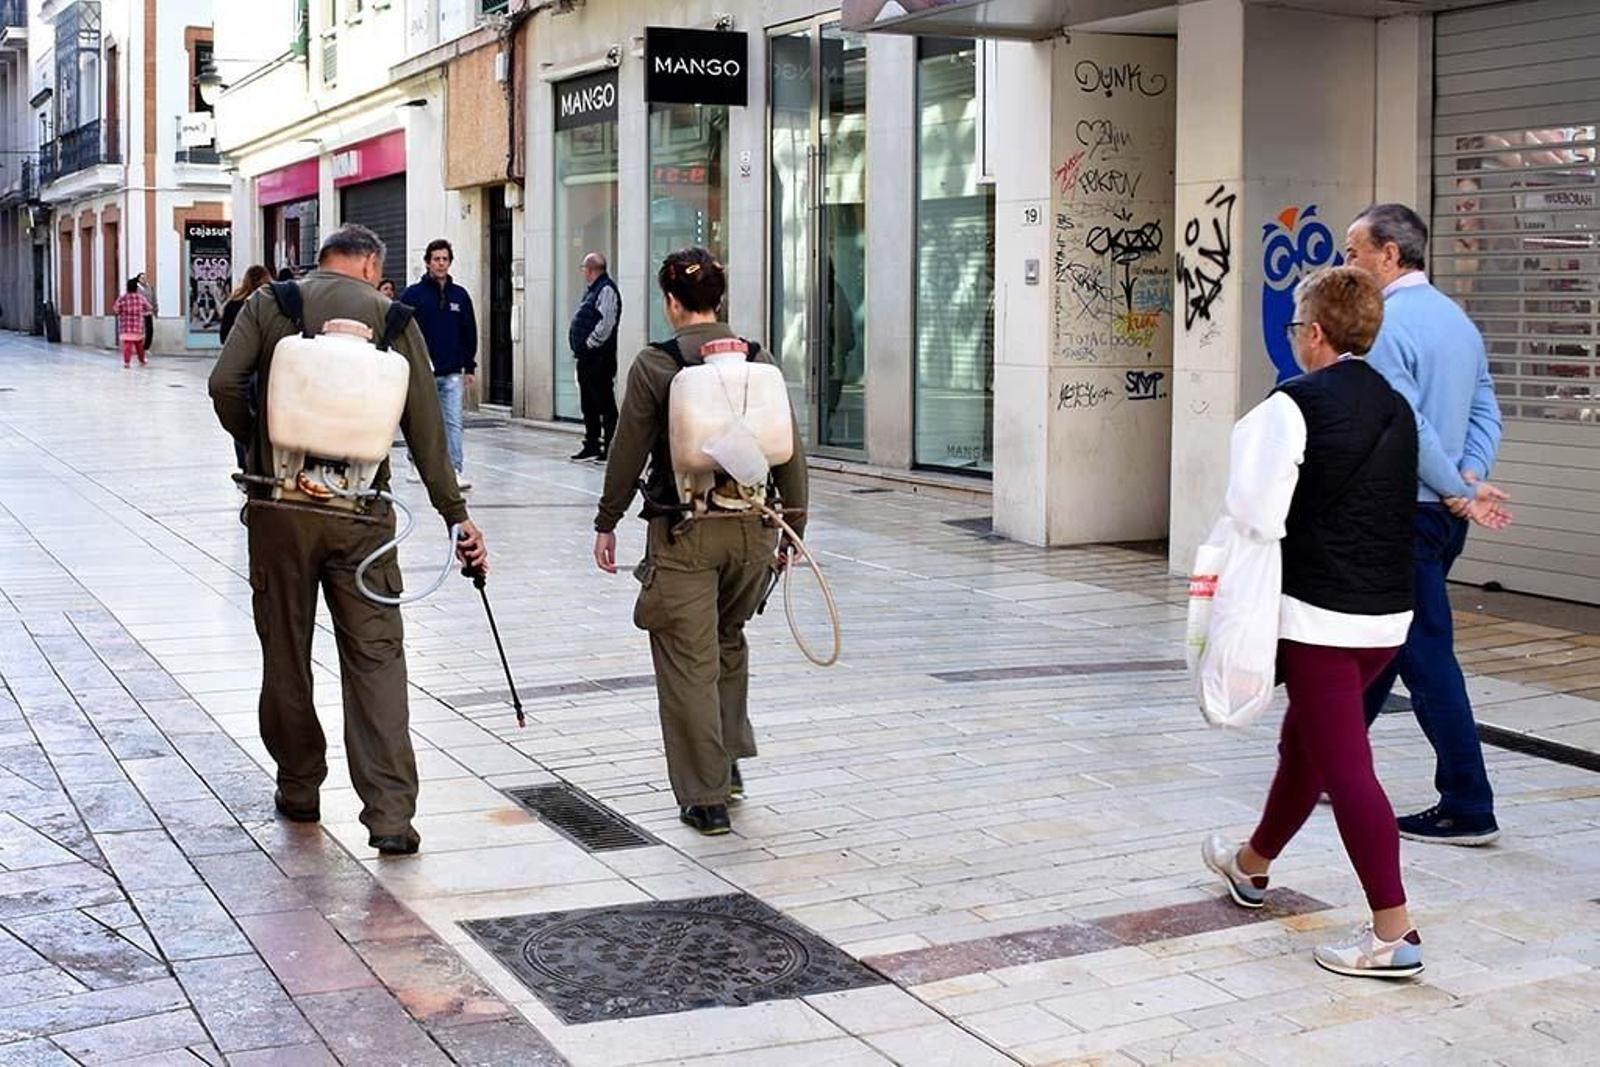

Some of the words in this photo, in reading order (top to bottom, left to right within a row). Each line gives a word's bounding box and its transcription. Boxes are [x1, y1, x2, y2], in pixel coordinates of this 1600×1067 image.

[655, 56, 740, 76] MANGO
[561, 83, 615, 117] MANGO
[1024, 208, 1038, 223] 19
[189, 225, 230, 238] cajasur
